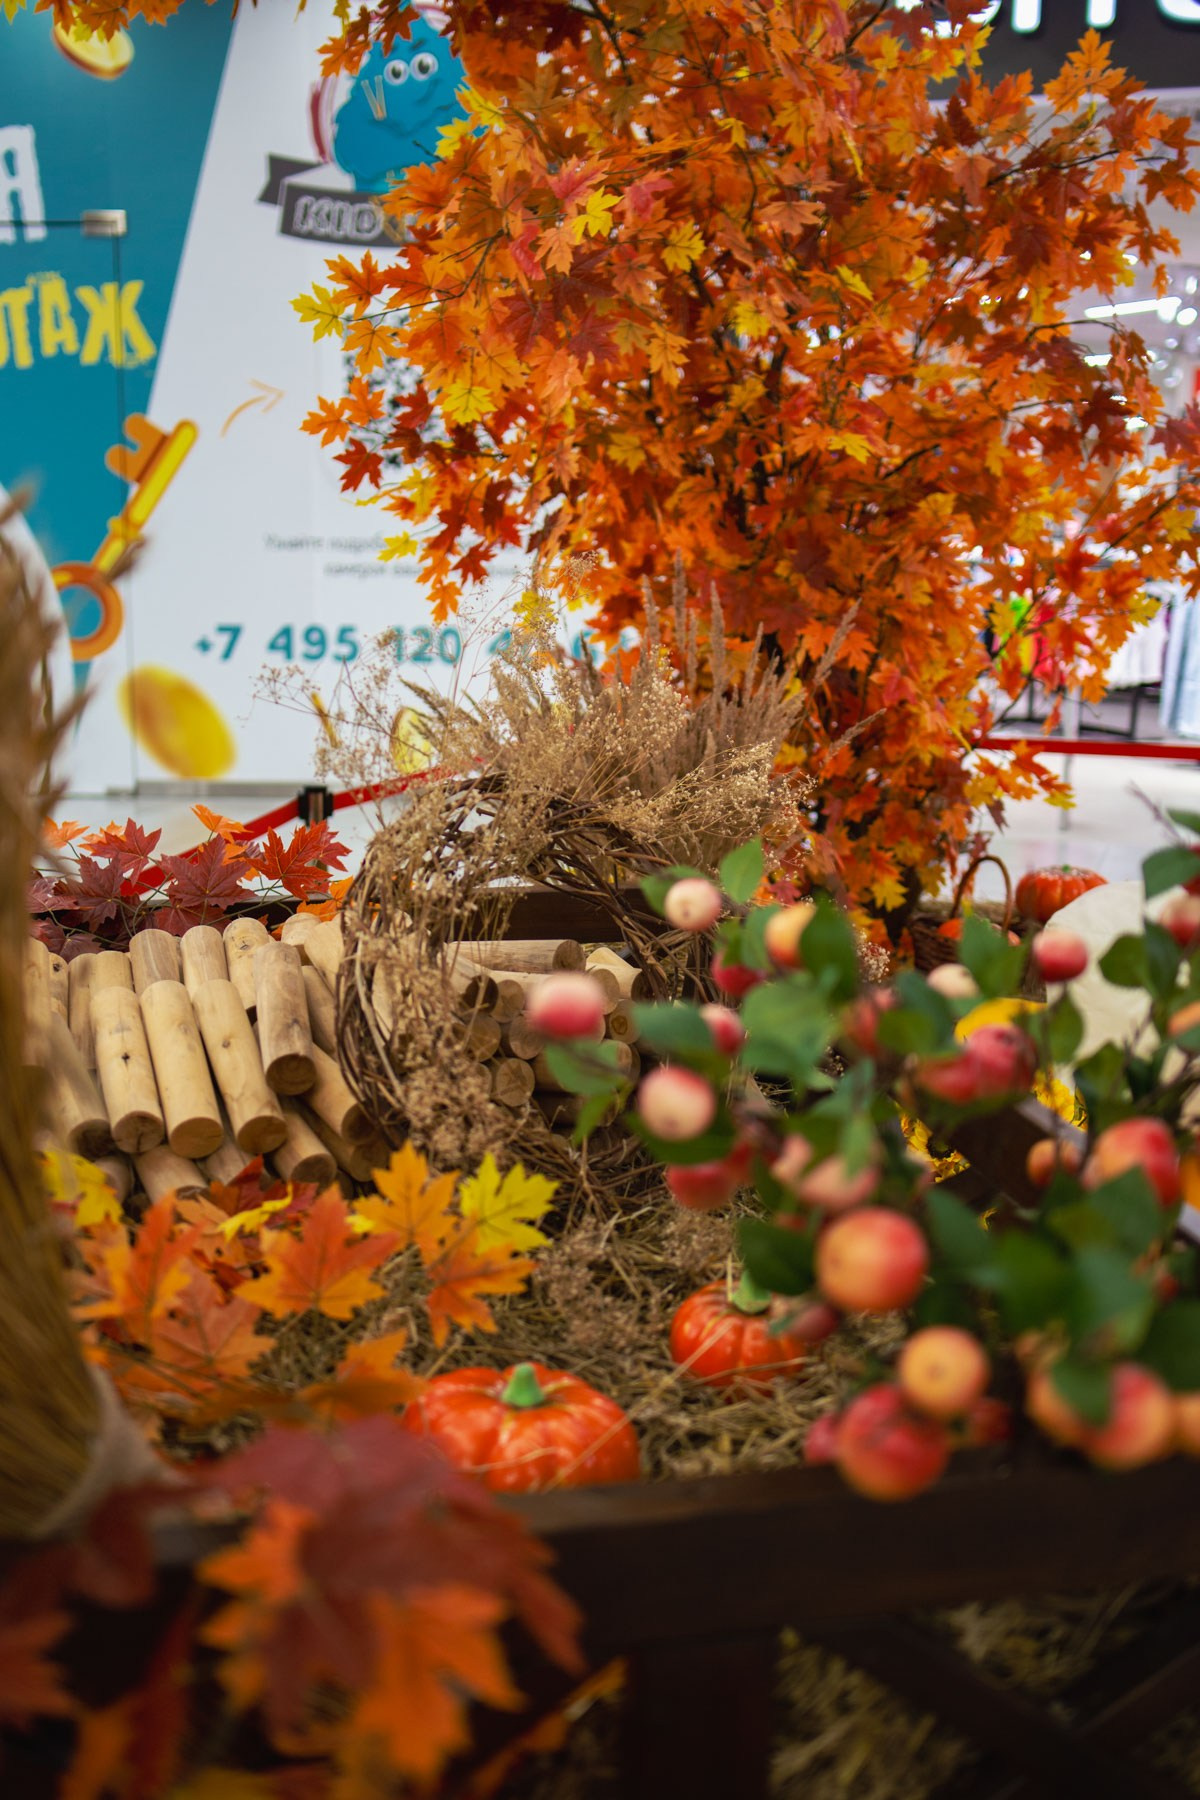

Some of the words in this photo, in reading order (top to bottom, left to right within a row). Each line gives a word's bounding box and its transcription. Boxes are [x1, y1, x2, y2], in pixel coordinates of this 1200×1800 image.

[293, 195, 418, 243] KID
[0, 271, 156, 369] ТАЖ
[195, 624, 242, 661] +7
[268, 624, 359, 662] 495
[392, 627, 461, 664] 120
